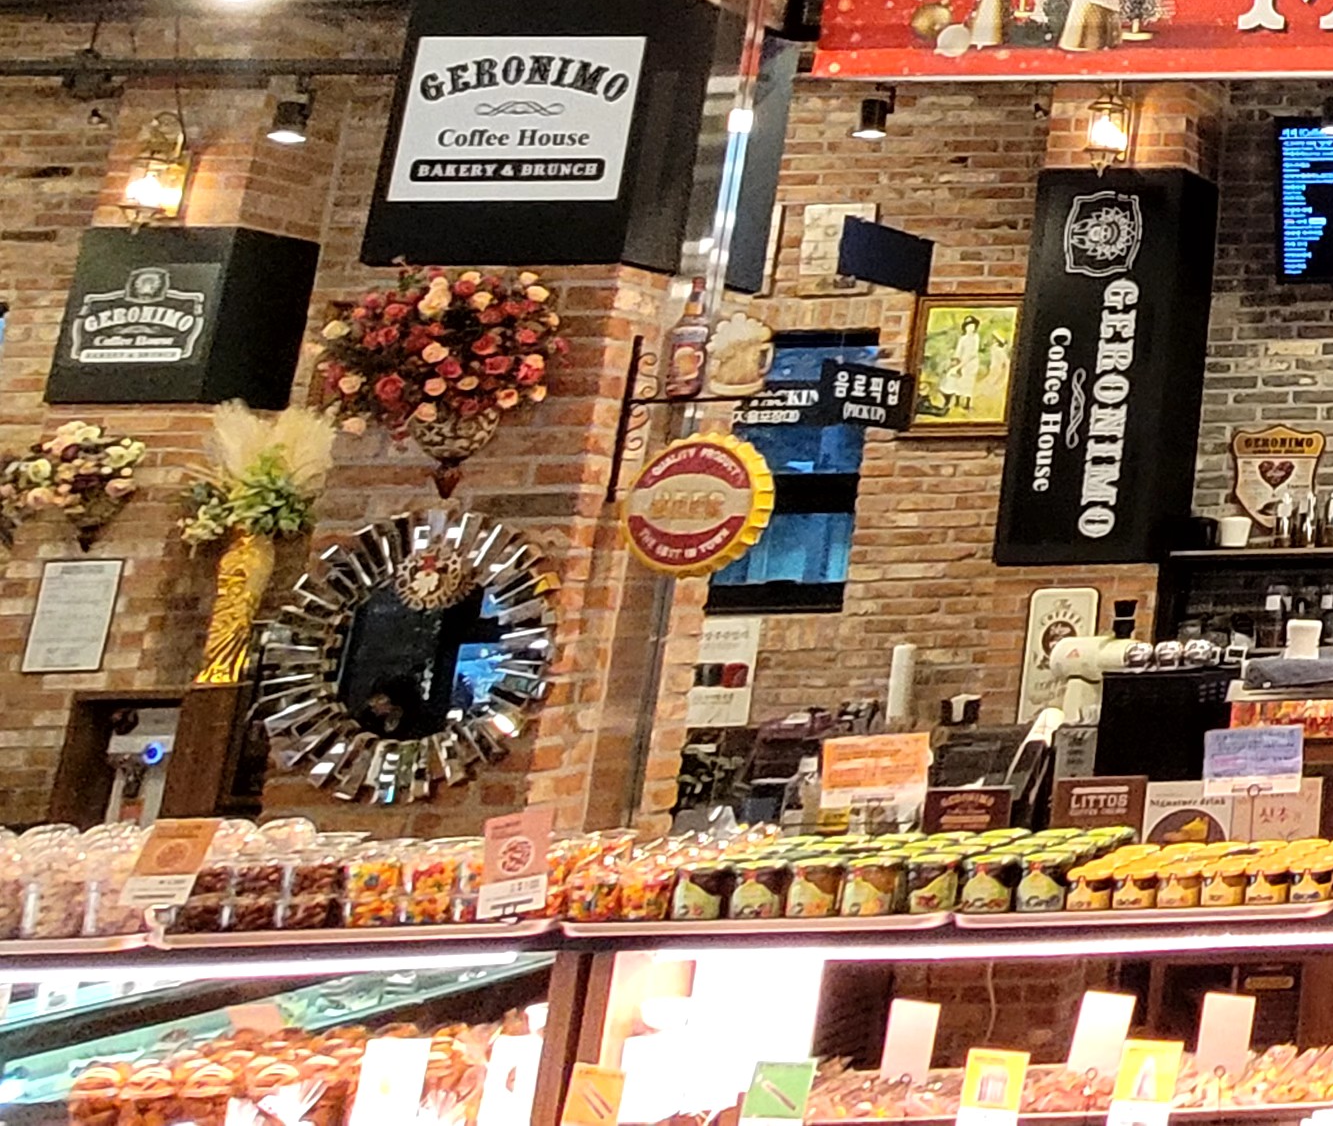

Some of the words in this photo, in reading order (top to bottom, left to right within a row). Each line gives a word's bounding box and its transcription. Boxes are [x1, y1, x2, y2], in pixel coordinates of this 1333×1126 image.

[419, 55, 630, 102] GERONIMO
[437, 128, 510, 147] Coffee
[516, 128, 590, 147] House
[416, 163, 498, 177] BAKERY
[500, 164, 515, 177] &
[520, 162, 598, 176] BRUNCH
[83, 305, 195, 332] GERONIMO
[1042, 325, 1073, 406] Coffee
[1077, 277, 1141, 539] GERONIMO
[1031, 410, 1063, 493] House
[1244, 437, 1314, 449] GERONIMO
[1069, 793, 1129, 809] LITTOS
